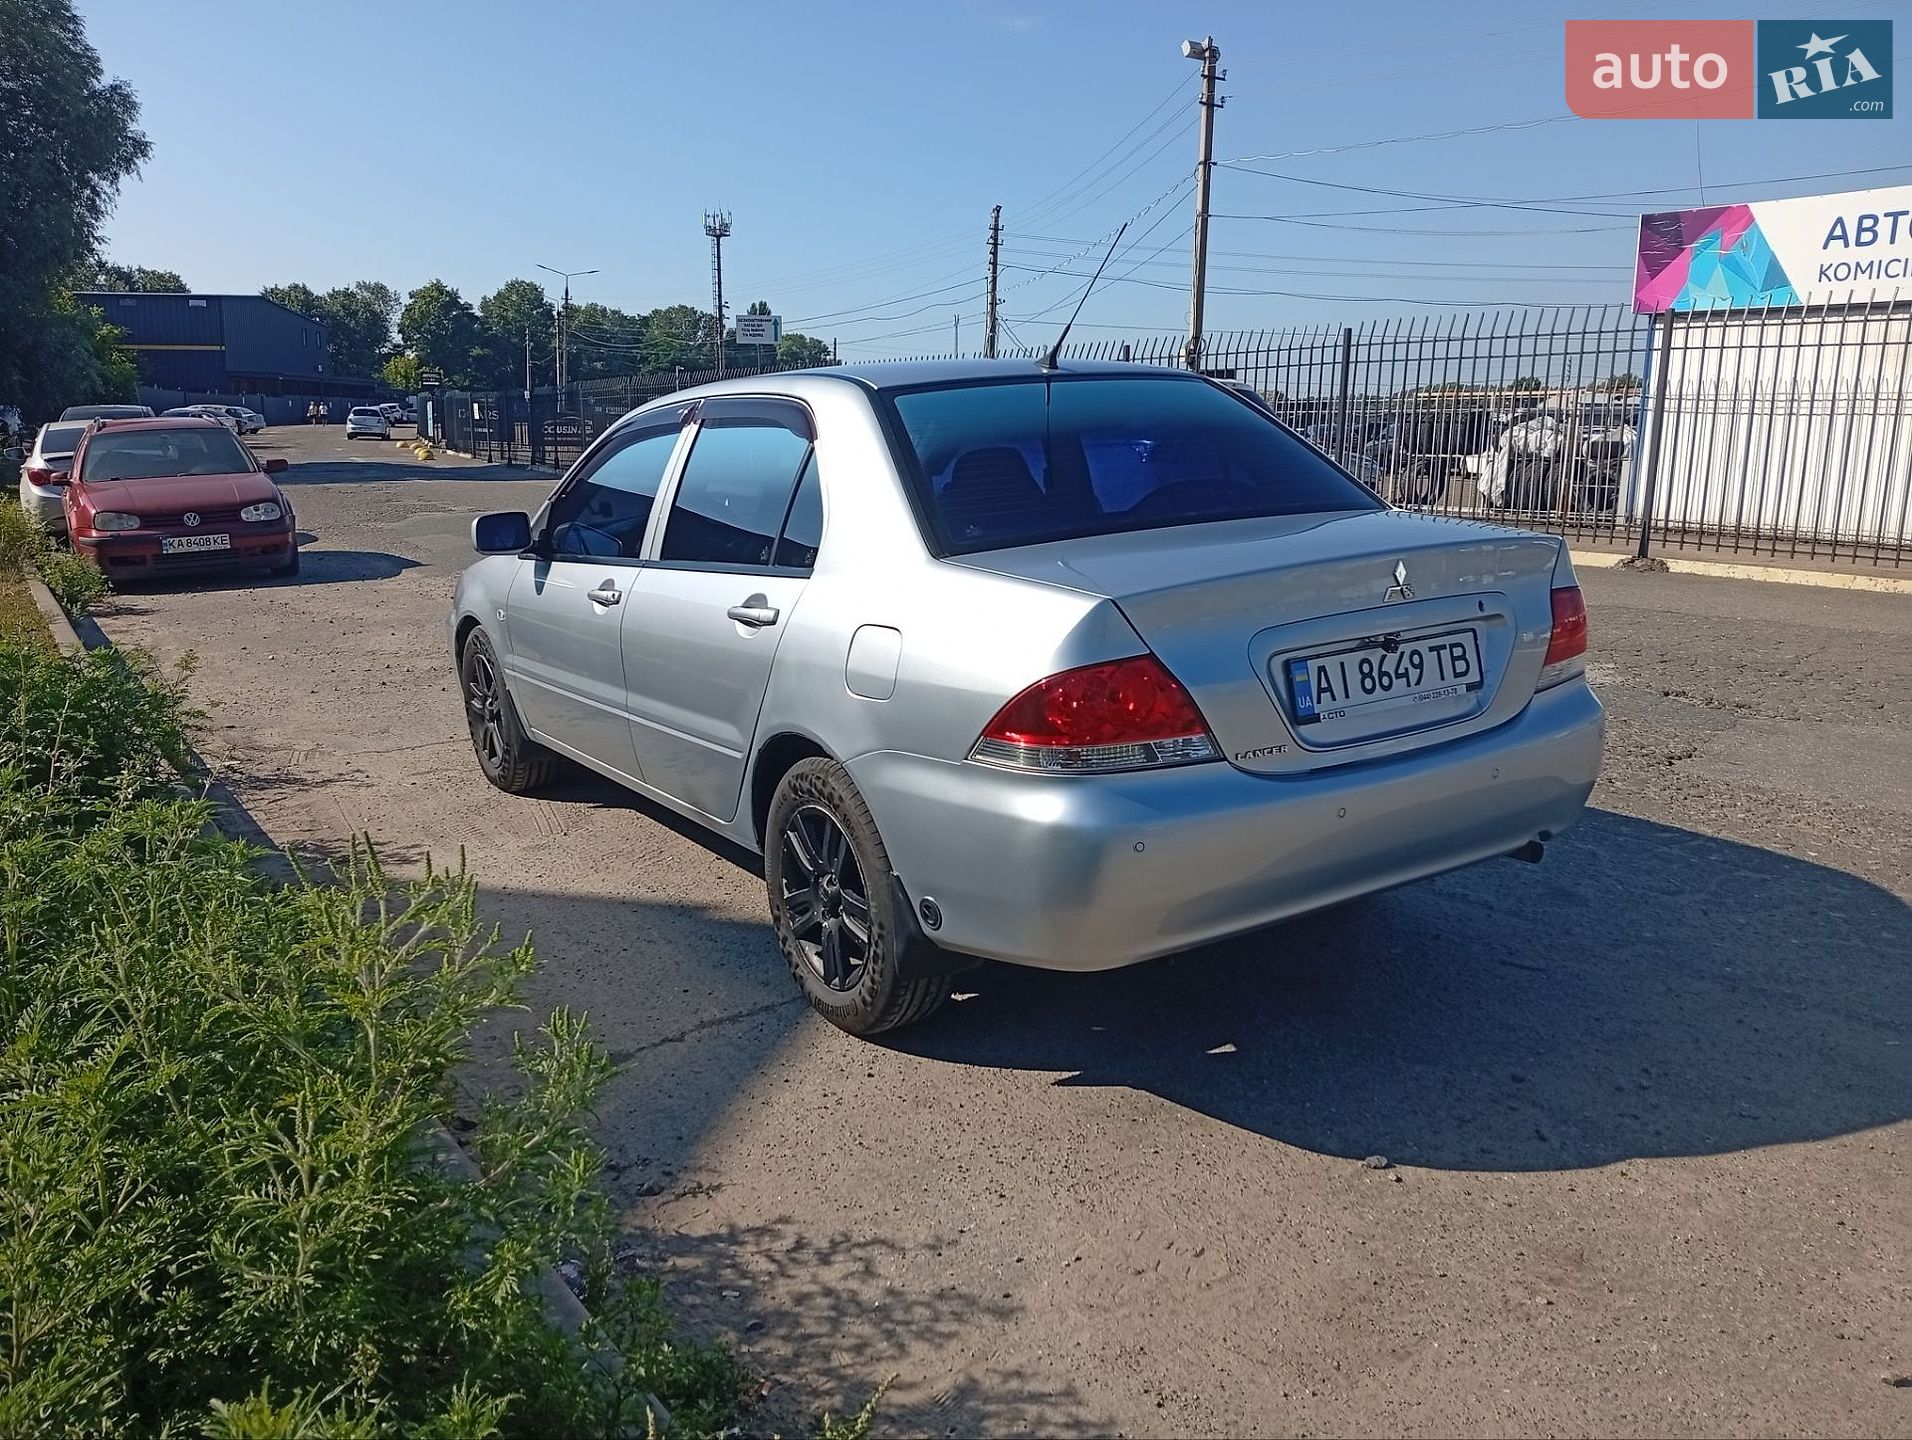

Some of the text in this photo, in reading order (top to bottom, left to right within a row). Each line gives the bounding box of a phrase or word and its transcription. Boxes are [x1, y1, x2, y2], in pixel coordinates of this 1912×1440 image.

[1818, 257, 1912, 283] КОМІСІ
[169, 535, 229, 549] KA 8408 KE
[1316, 642, 1471, 704] AI 8649 TB
[1298, 695, 1313, 709] UA
[1235, 744, 1289, 761] LANCER
